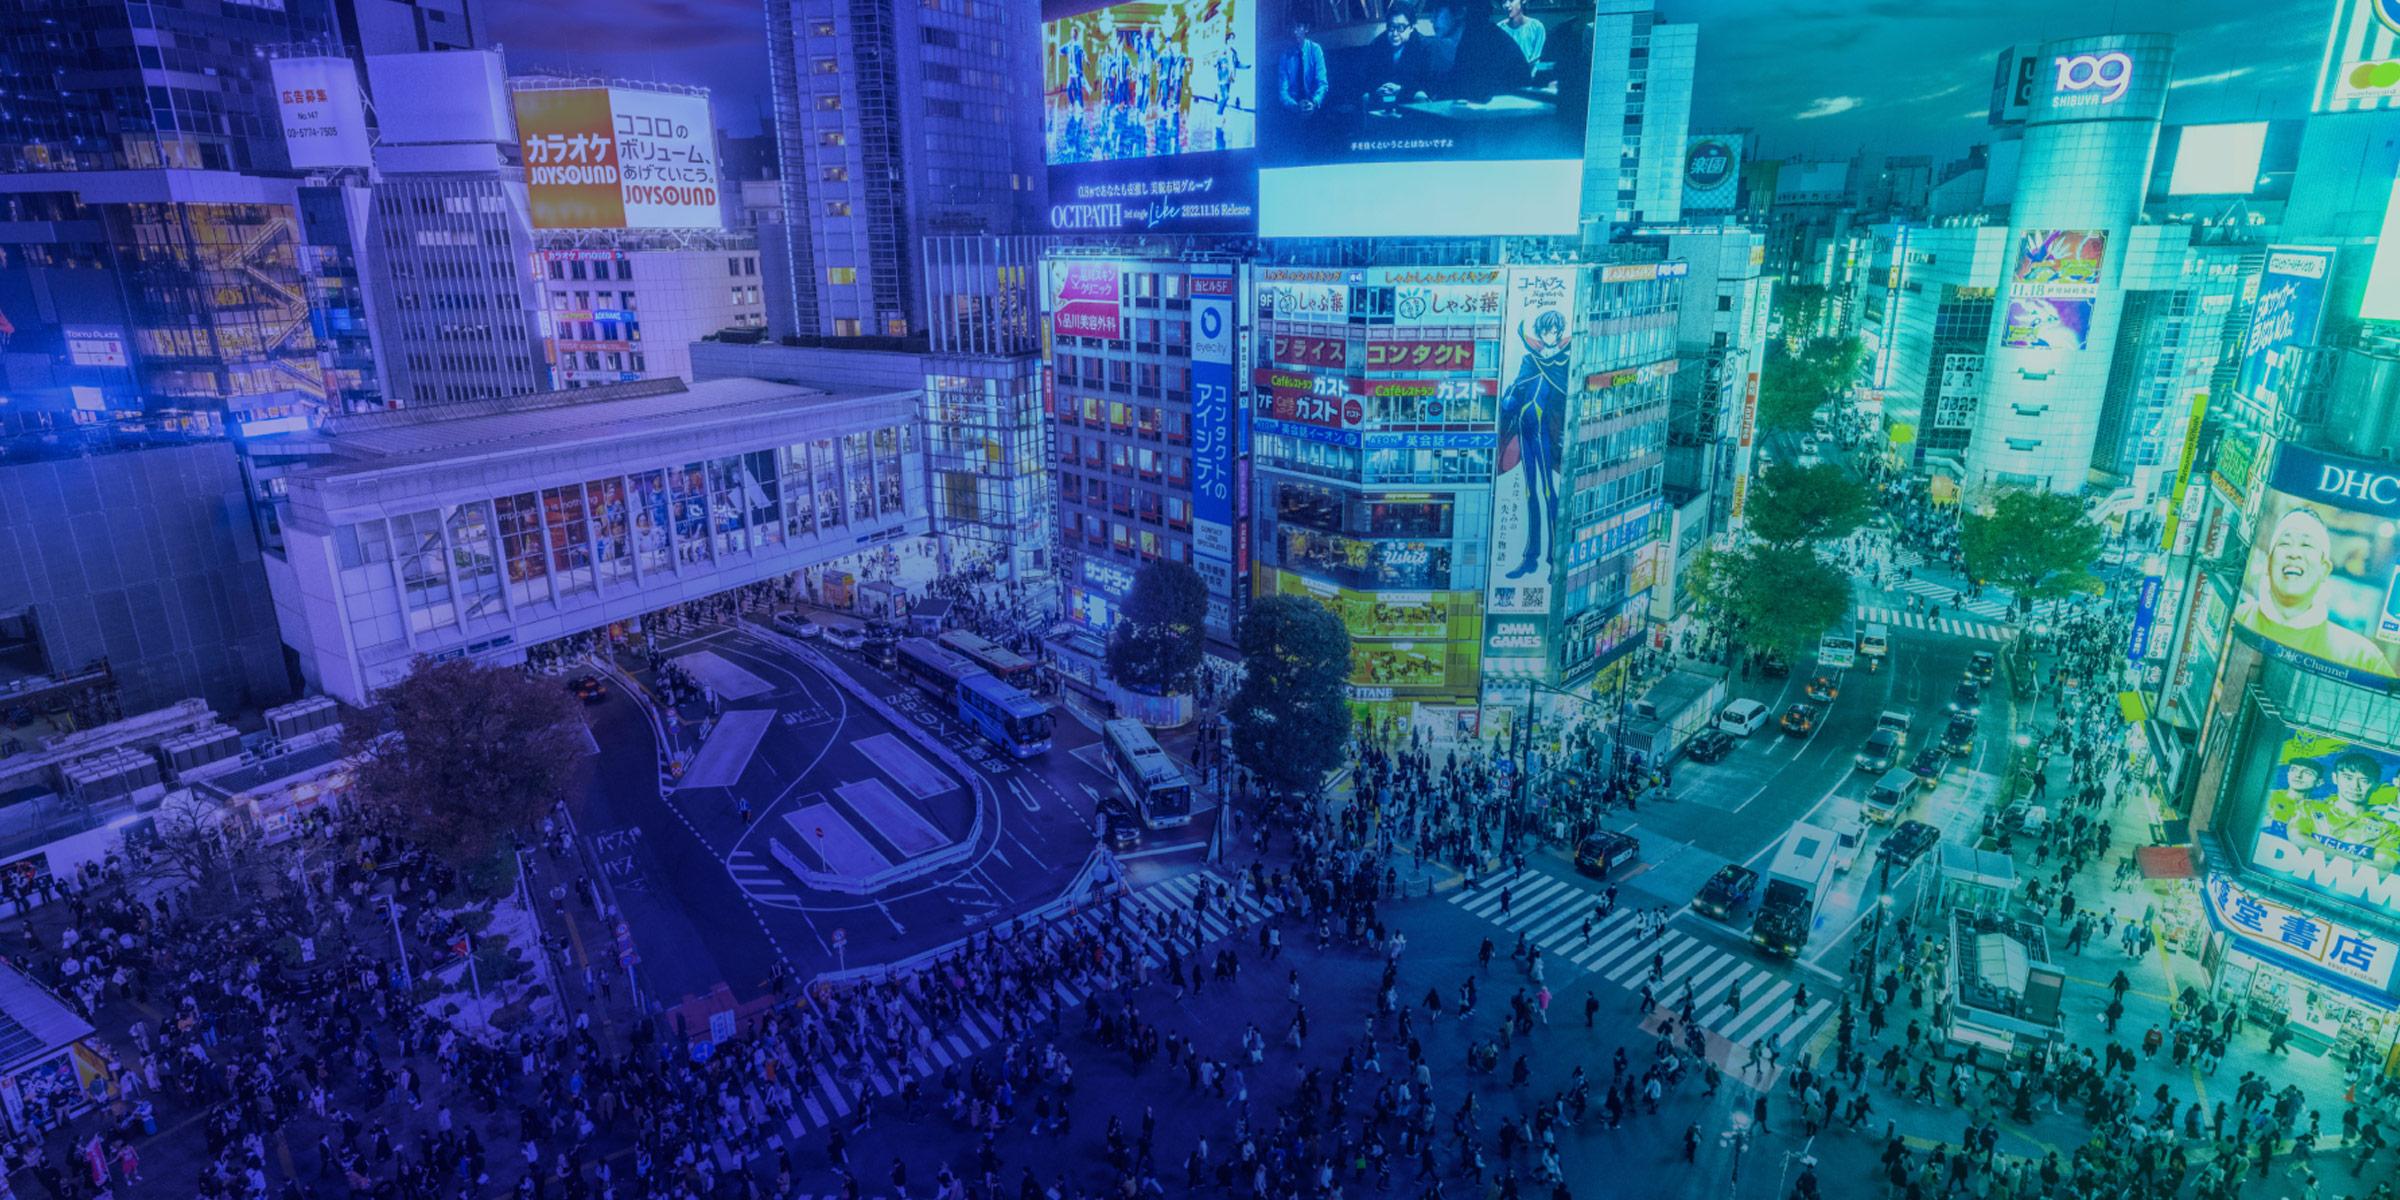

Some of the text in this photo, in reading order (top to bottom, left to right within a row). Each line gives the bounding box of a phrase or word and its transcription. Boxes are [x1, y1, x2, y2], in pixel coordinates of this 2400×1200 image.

[2055, 52, 2133, 104] 109
[2053, 94, 2099, 107] SHIBUYA
[616, 114, 688, 139] ココロの
[526, 133, 611, 163] カラオケ
[620, 138, 711, 165] ボリューム、
[531, 165, 617, 185] JOYSOUND
[623, 164, 714, 184] あげていこう。
[624, 185, 716, 206] JOYSOUND
[1051, 203, 1121, 228] OCTPATH
[1432, 292, 1499, 313] しゃぶ葉
[1368, 344, 1472, 365] コンタクト
[1313, 376, 1349, 397] ガスト
[1437, 381, 1487, 401] ガスト
[1296, 397, 1338, 422] ガスト
[1406, 433, 1495, 448] 英会話イーオン
[2317, 464, 2400, 505] DHC
[2303, 656, 2350, 679] Channel
